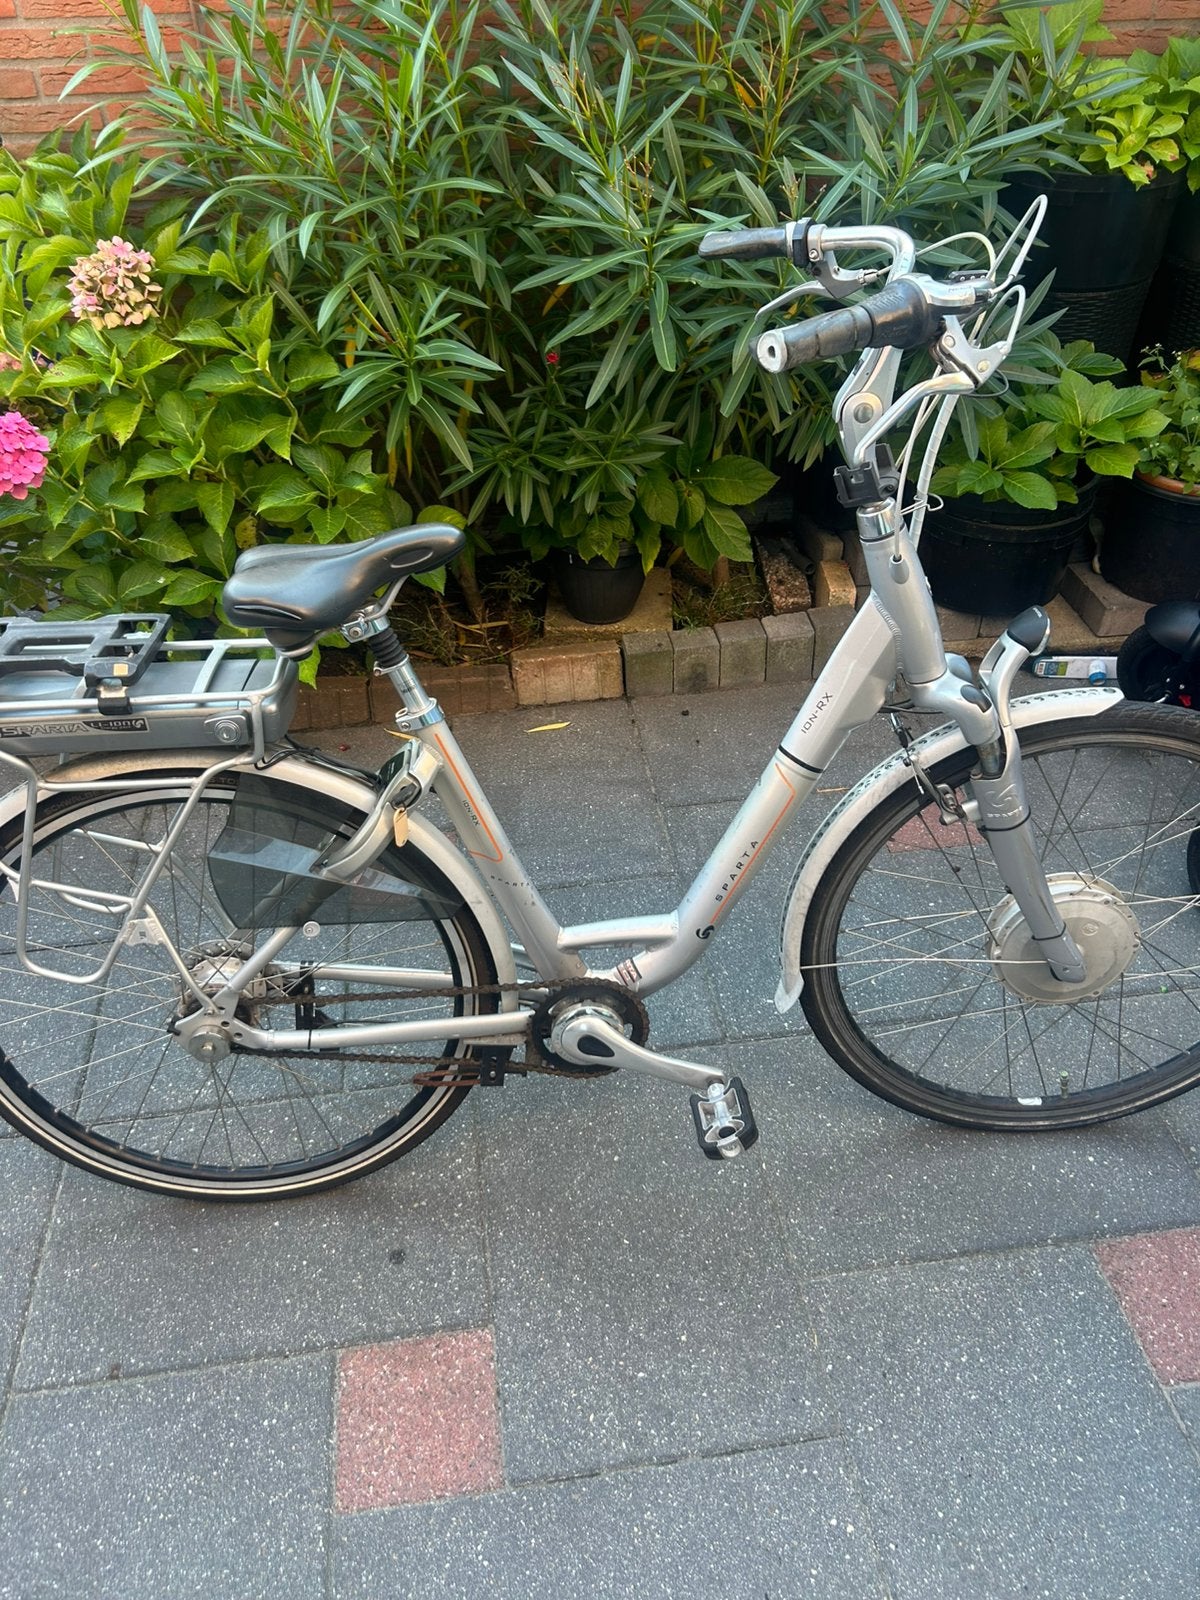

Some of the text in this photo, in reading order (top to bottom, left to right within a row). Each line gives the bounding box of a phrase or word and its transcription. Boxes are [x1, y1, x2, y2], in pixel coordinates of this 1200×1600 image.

[2, 723, 89, 736] SPARTA
[801, 692, 833, 734] ION-RX
[715, 841, 759, 902] SPARTA
